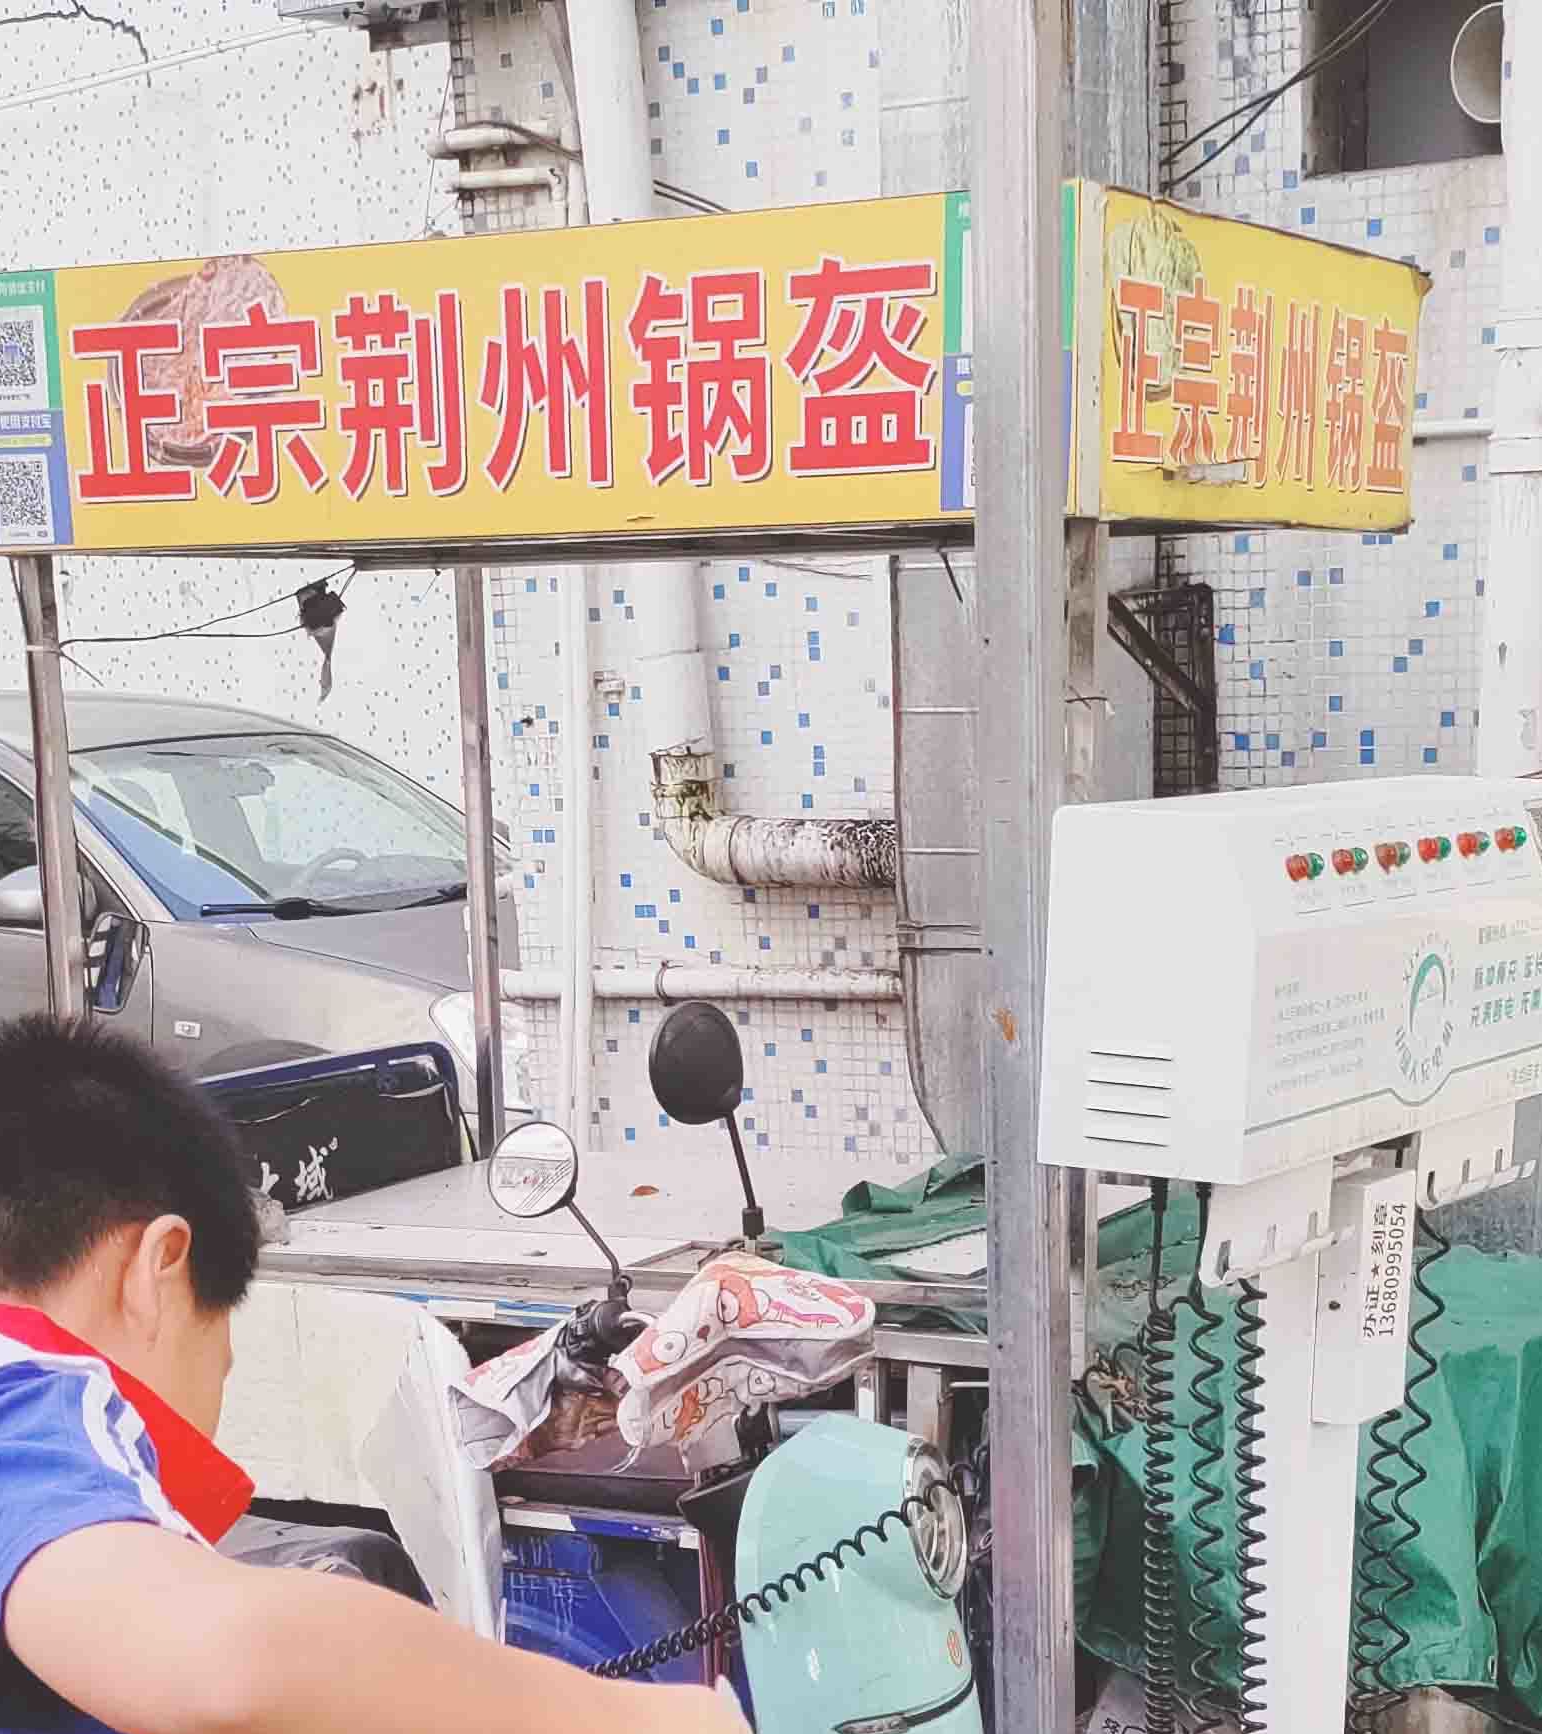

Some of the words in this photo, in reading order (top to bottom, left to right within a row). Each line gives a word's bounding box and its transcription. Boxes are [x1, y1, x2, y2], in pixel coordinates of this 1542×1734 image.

[70, 256, 937, 503] 正宗荆州锅盔
[1112, 278, 1409, 492] 正宗荆州锅盔
[1377, 1202, 1408, 1338] 13680995054
